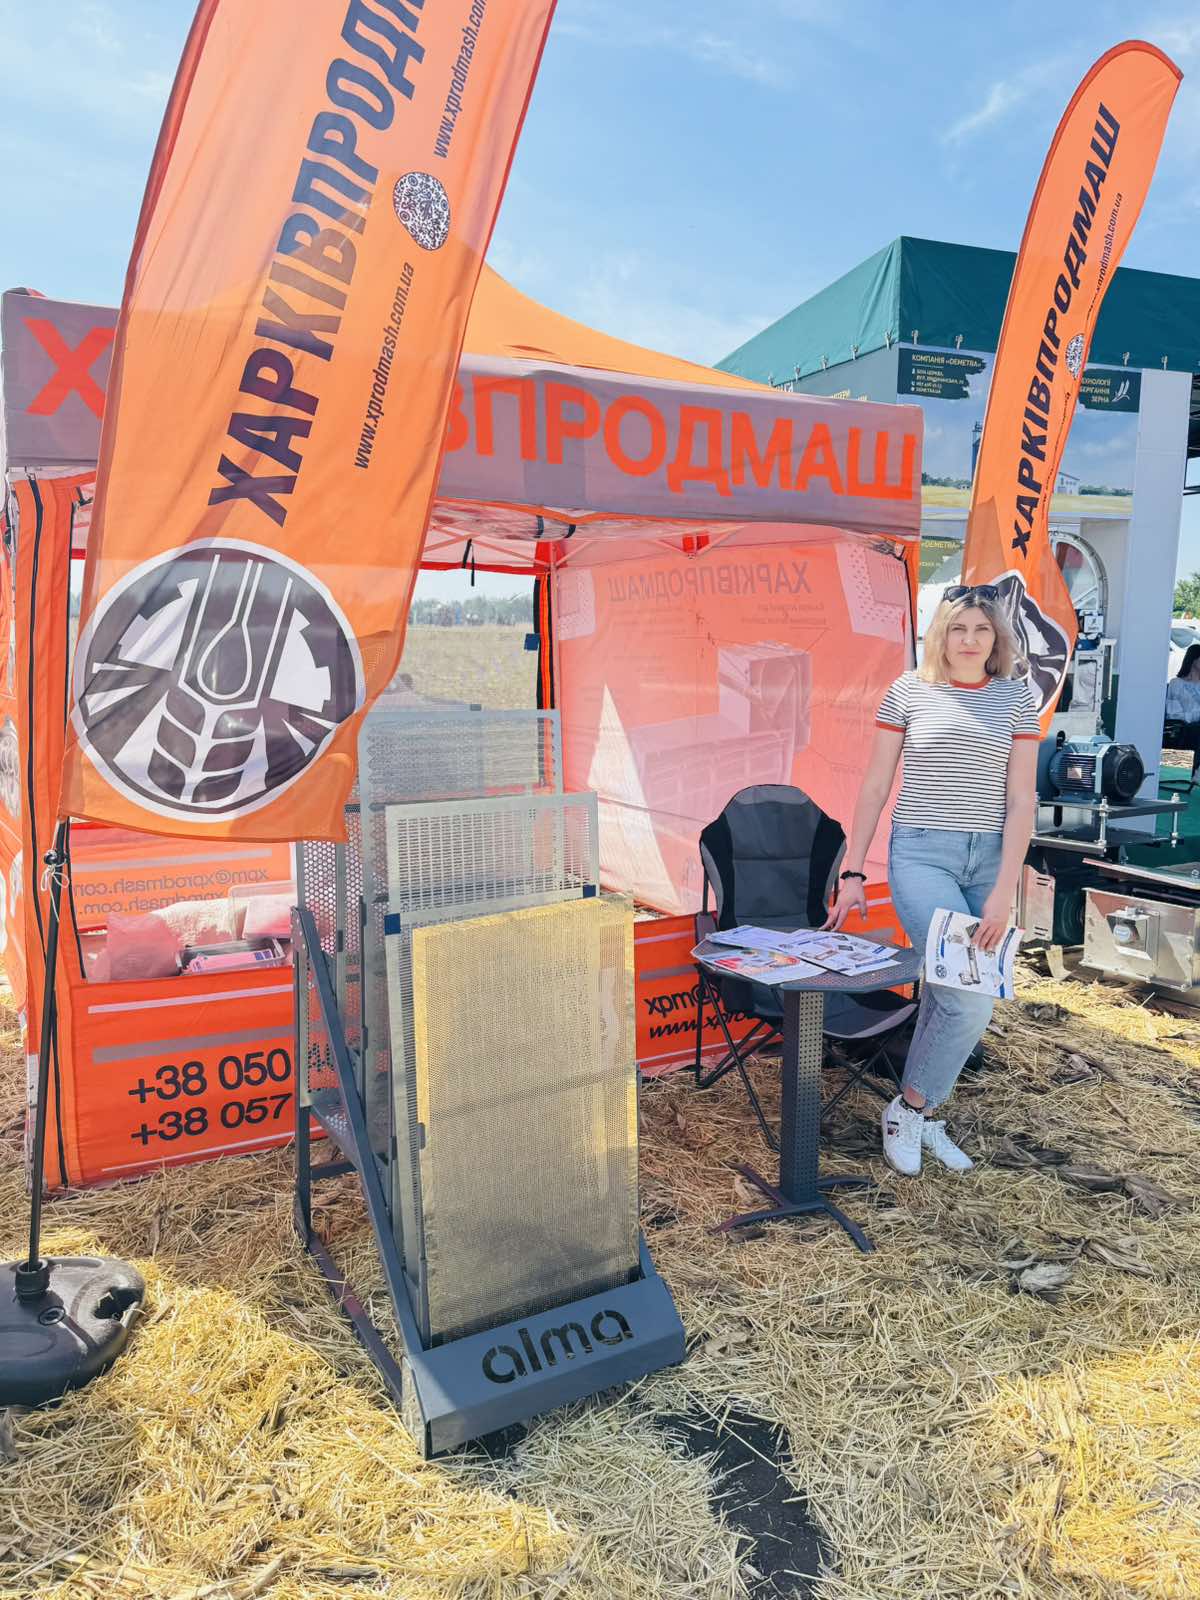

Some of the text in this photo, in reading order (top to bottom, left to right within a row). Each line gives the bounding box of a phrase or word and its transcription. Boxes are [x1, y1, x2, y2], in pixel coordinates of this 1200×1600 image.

[354, 261, 415, 470] www.xprodmash.com.ua
[1011, 101, 1121, 560] ХАРКІВПРОДМАШ
[128, 1061, 208, 1103] +38
[218, 1048, 291, 1090] 050
[131, 1092, 293, 1145] +38 057
[481, 1308, 635, 1384] alma
